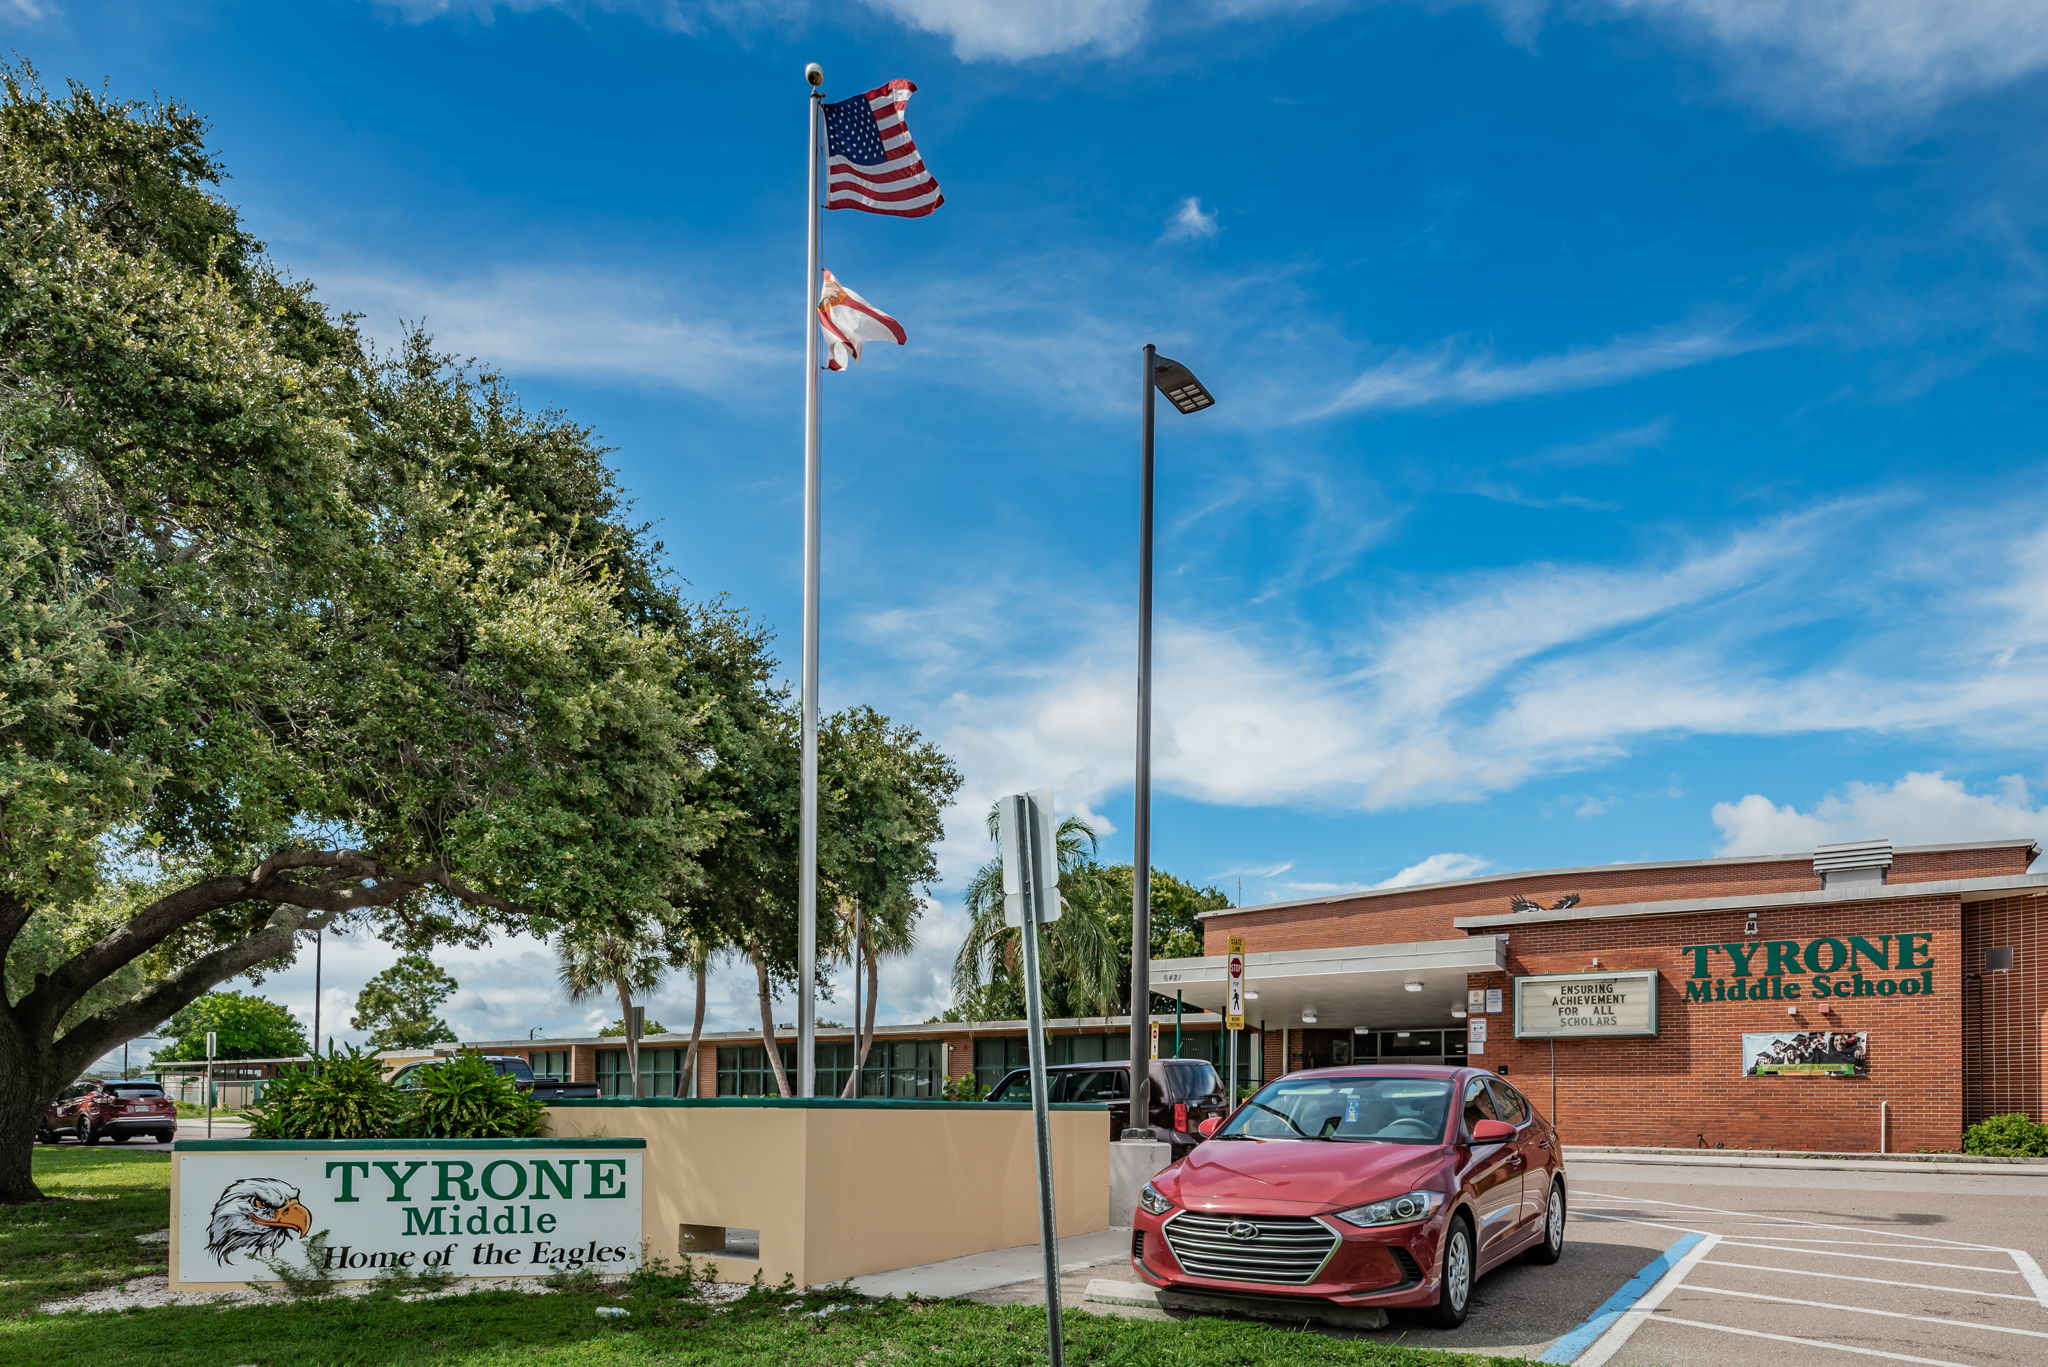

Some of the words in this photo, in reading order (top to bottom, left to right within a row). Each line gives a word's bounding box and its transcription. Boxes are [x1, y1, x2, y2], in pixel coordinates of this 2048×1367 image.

[1682, 932, 1935, 978] TYRONE
[1230, 963, 1242, 972] STOP
[1561, 984, 1613, 995] ENSURING
[1683, 976, 1801, 1002] Middle
[1811, 971, 1935, 998] School
[1552, 994, 1626, 1006] ACHIEVEMENT
[1558, 1007, 1578, 1016] FOR
[1593, 1006, 1614, 1015] ALL
[1560, 1016, 1617, 1027] SCHOLARS
[325, 1159, 627, 1202] TYRONE
[401, 1205, 557, 1236] Middle
[322, 1246, 416, 1269] Home
[423, 1243, 458, 1266] of
[472, 1242, 521, 1265] the
[530, 1240, 627, 1270] Eagles
